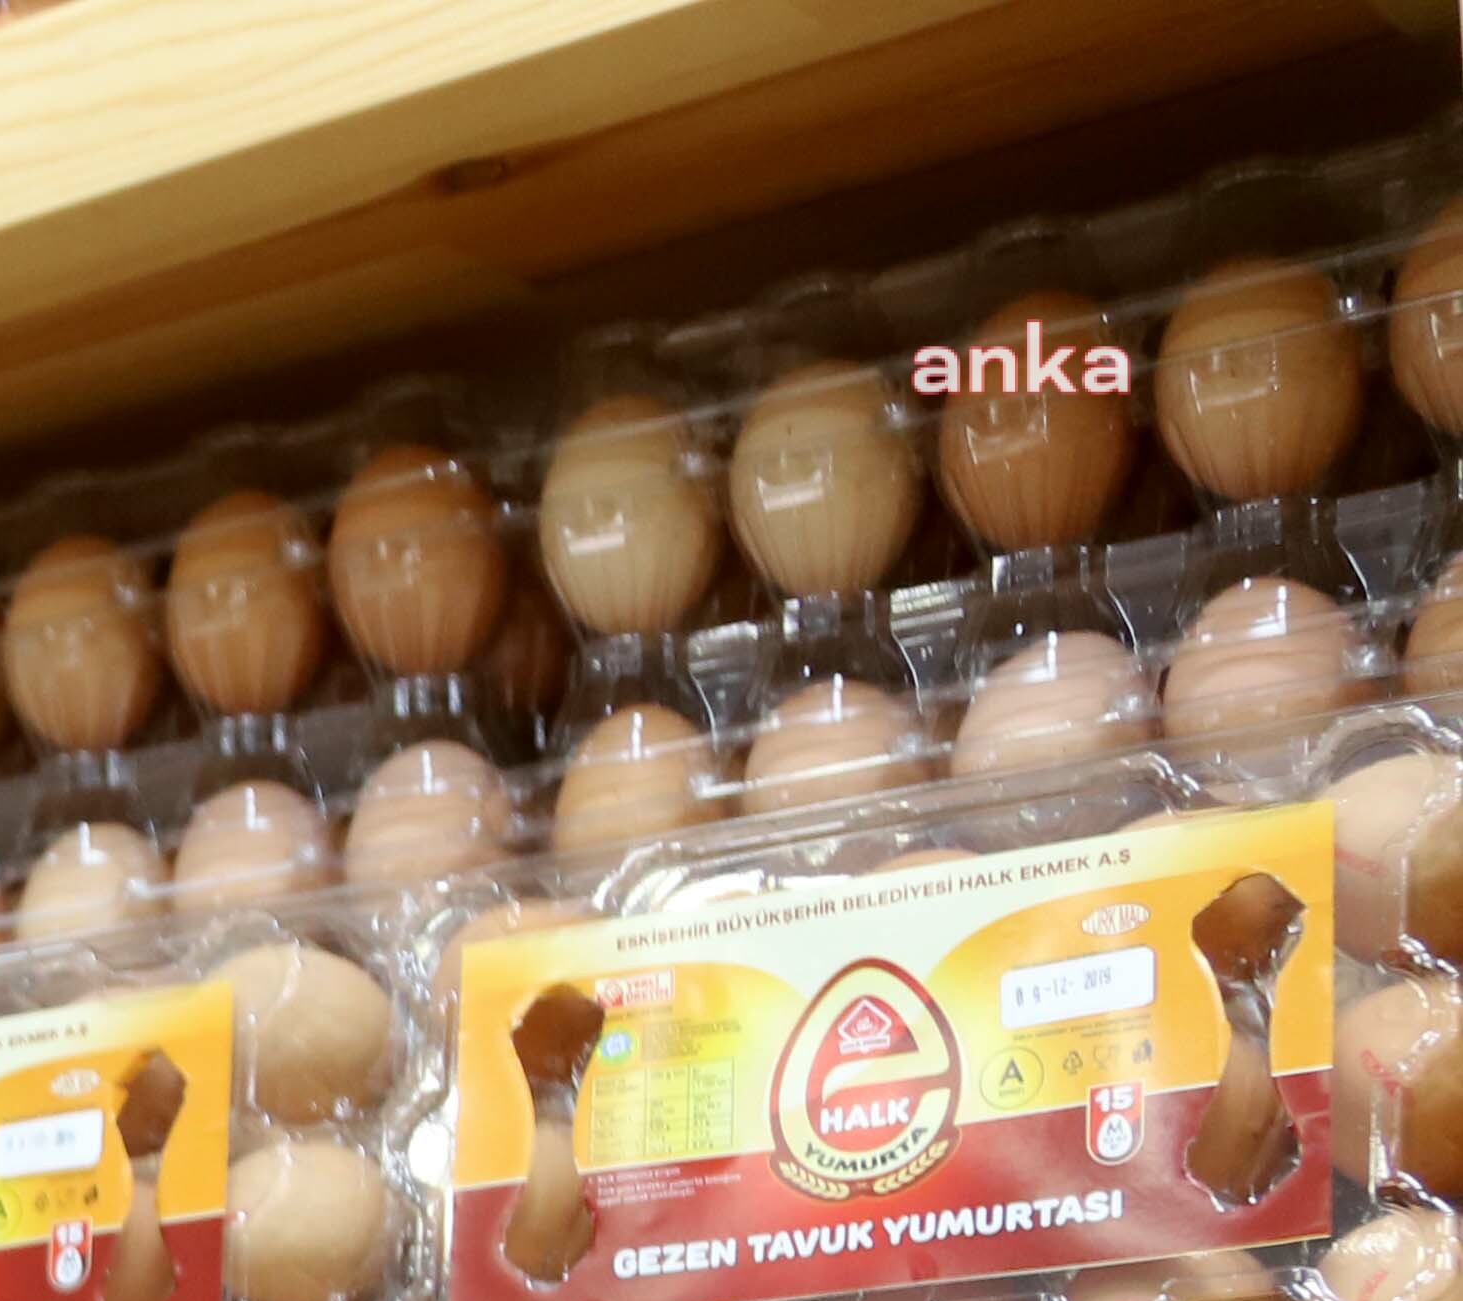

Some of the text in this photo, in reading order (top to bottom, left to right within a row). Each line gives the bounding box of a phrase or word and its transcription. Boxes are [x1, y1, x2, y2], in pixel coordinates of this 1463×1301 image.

[617, 922, 710, 952] ESKİŞEHİR
[716, 897, 836, 934] BÜYÜKŞEHİR
[842, 875, 953, 913] BELEDİYESİ
[959, 869, 1013, 893] HALK
[1020, 856, 1090, 882] EKMEK
[1000, 1058, 1024, 1086] A
[820, 1097, 910, 1134] HALK
[1094, 1086, 1133, 1112] 15
[804, 1126, 929, 1173] YUMURTA
[614, 1190, 1123, 1279] GEZEN TAVUK YUMURTASI
